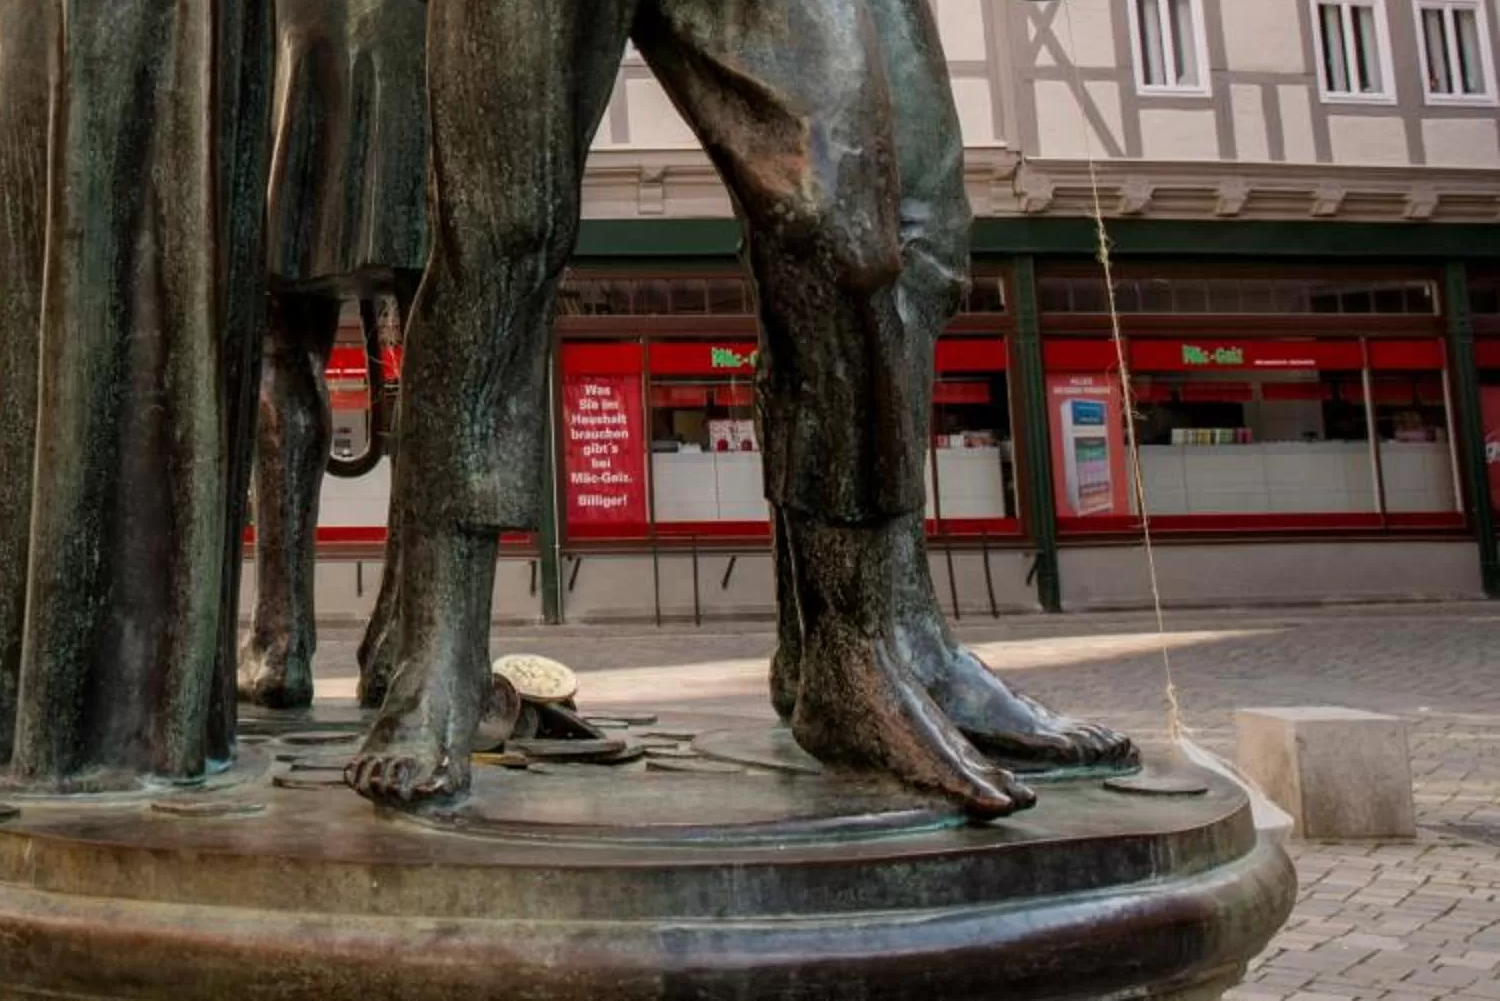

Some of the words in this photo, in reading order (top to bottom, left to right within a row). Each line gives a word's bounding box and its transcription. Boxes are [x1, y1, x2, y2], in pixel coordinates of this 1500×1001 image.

[584, 385, 612, 396] Was
[571, 414, 627, 425] Haushalt
[570, 428, 629, 440] brauchen
[577, 494, 628, 508] Billiger!
